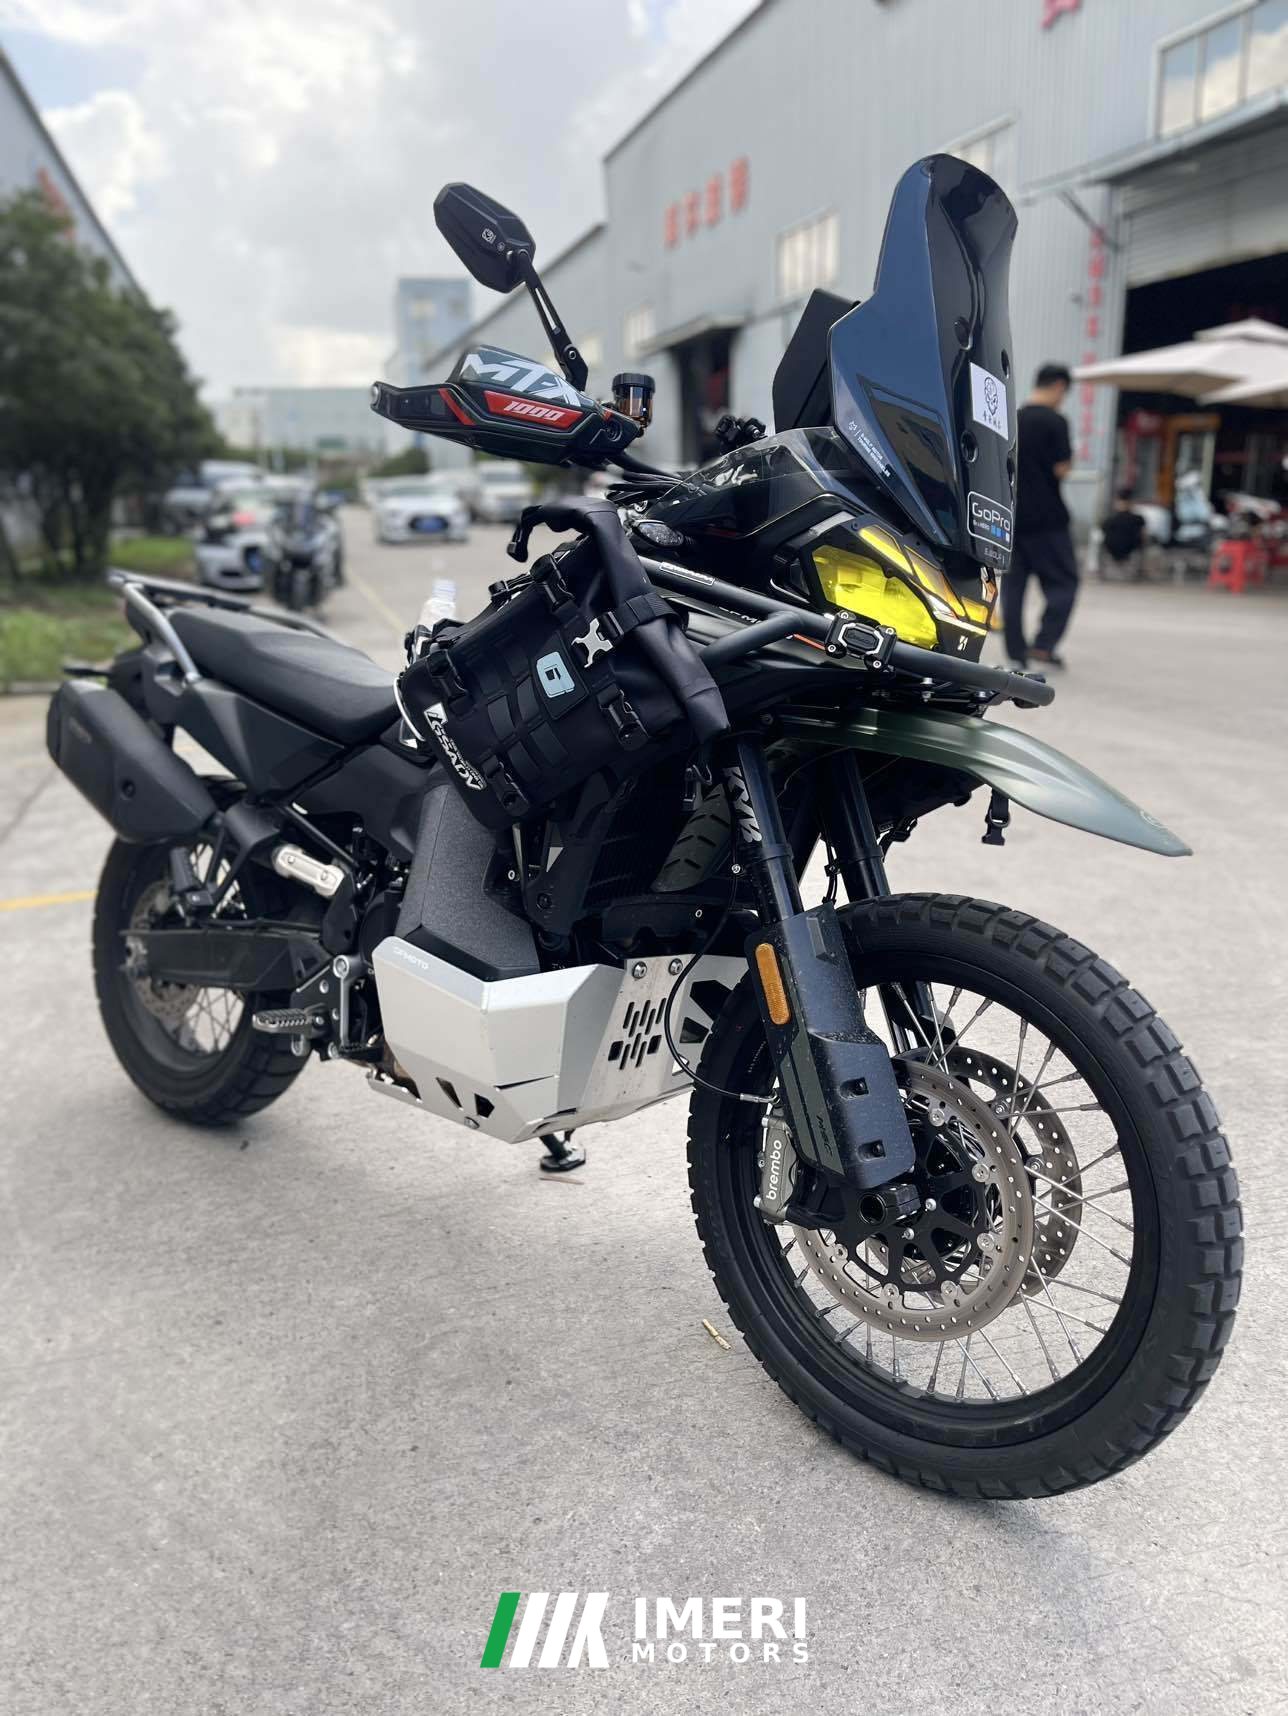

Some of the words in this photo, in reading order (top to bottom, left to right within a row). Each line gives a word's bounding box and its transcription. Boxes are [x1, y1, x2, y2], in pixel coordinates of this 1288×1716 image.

[503, 400, 566, 422] 1000
[972, 502, 1011, 531] GoPro
[765, 1140, 782, 1200] brembo
